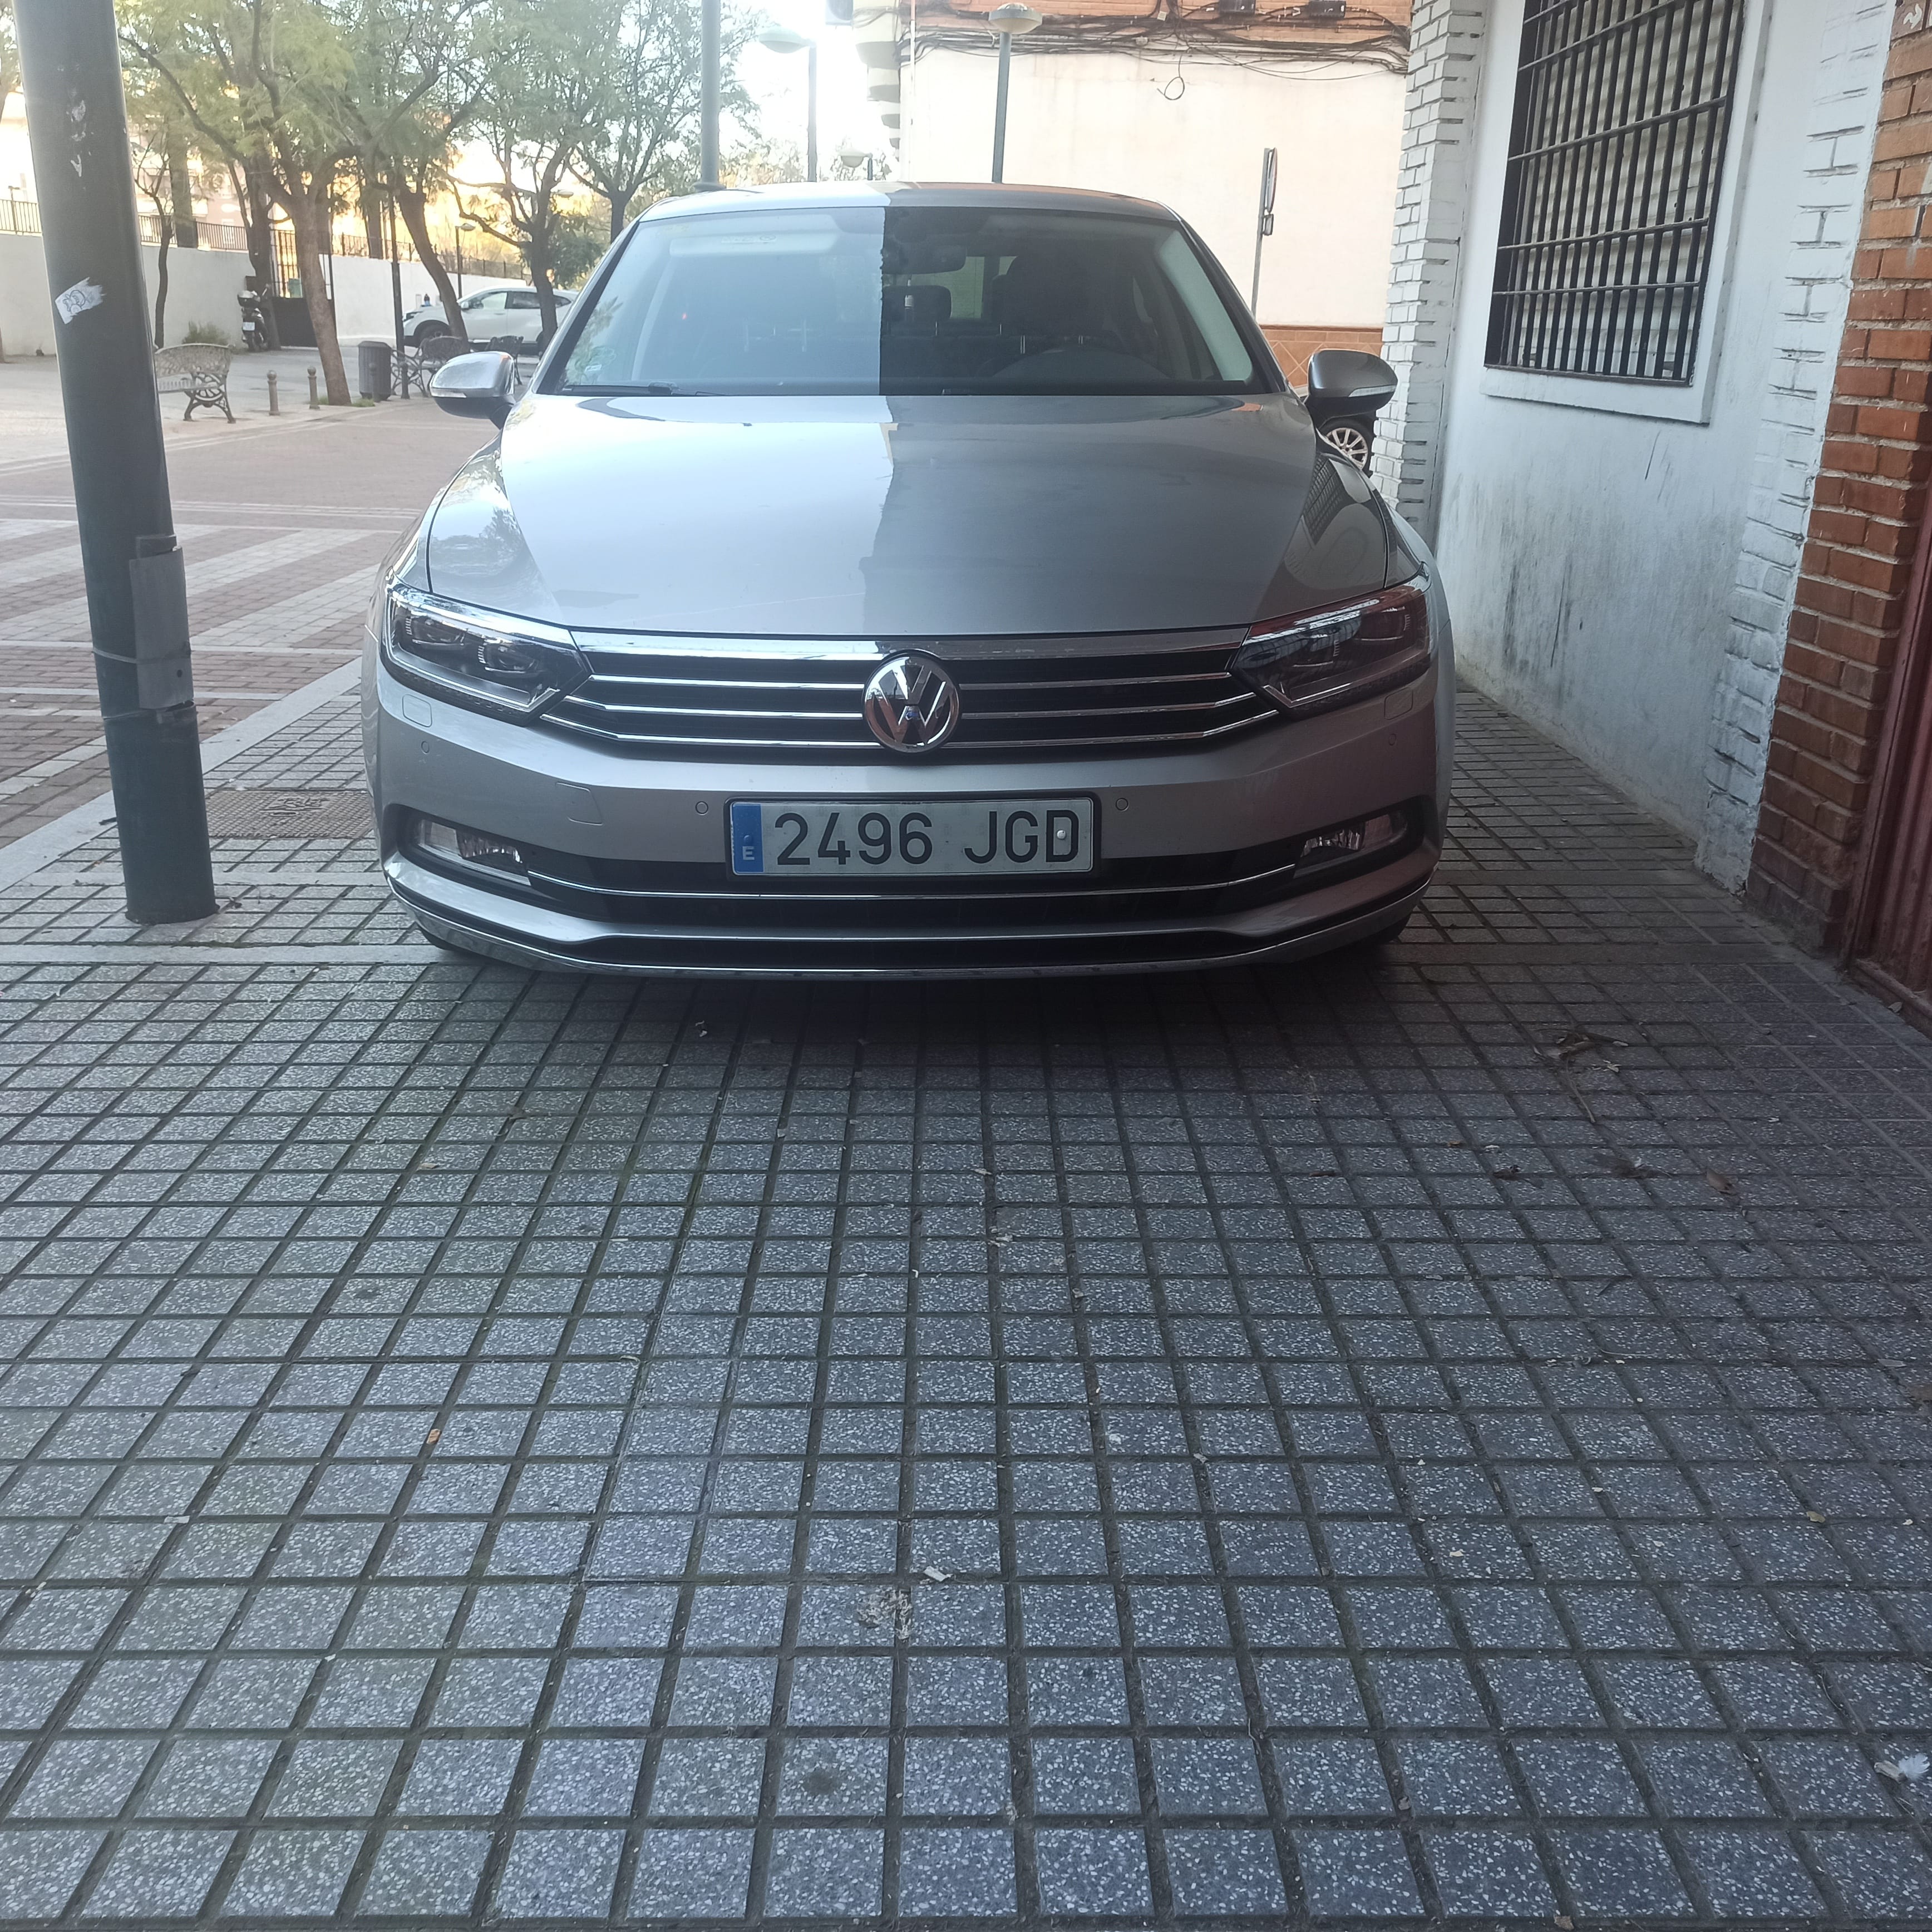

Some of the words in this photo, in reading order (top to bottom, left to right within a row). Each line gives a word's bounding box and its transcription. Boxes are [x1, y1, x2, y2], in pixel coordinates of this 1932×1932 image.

[742, 846, 755, 860] E
[775, 812, 933, 865] 2496
[964, 809, 1079, 864] JGD
